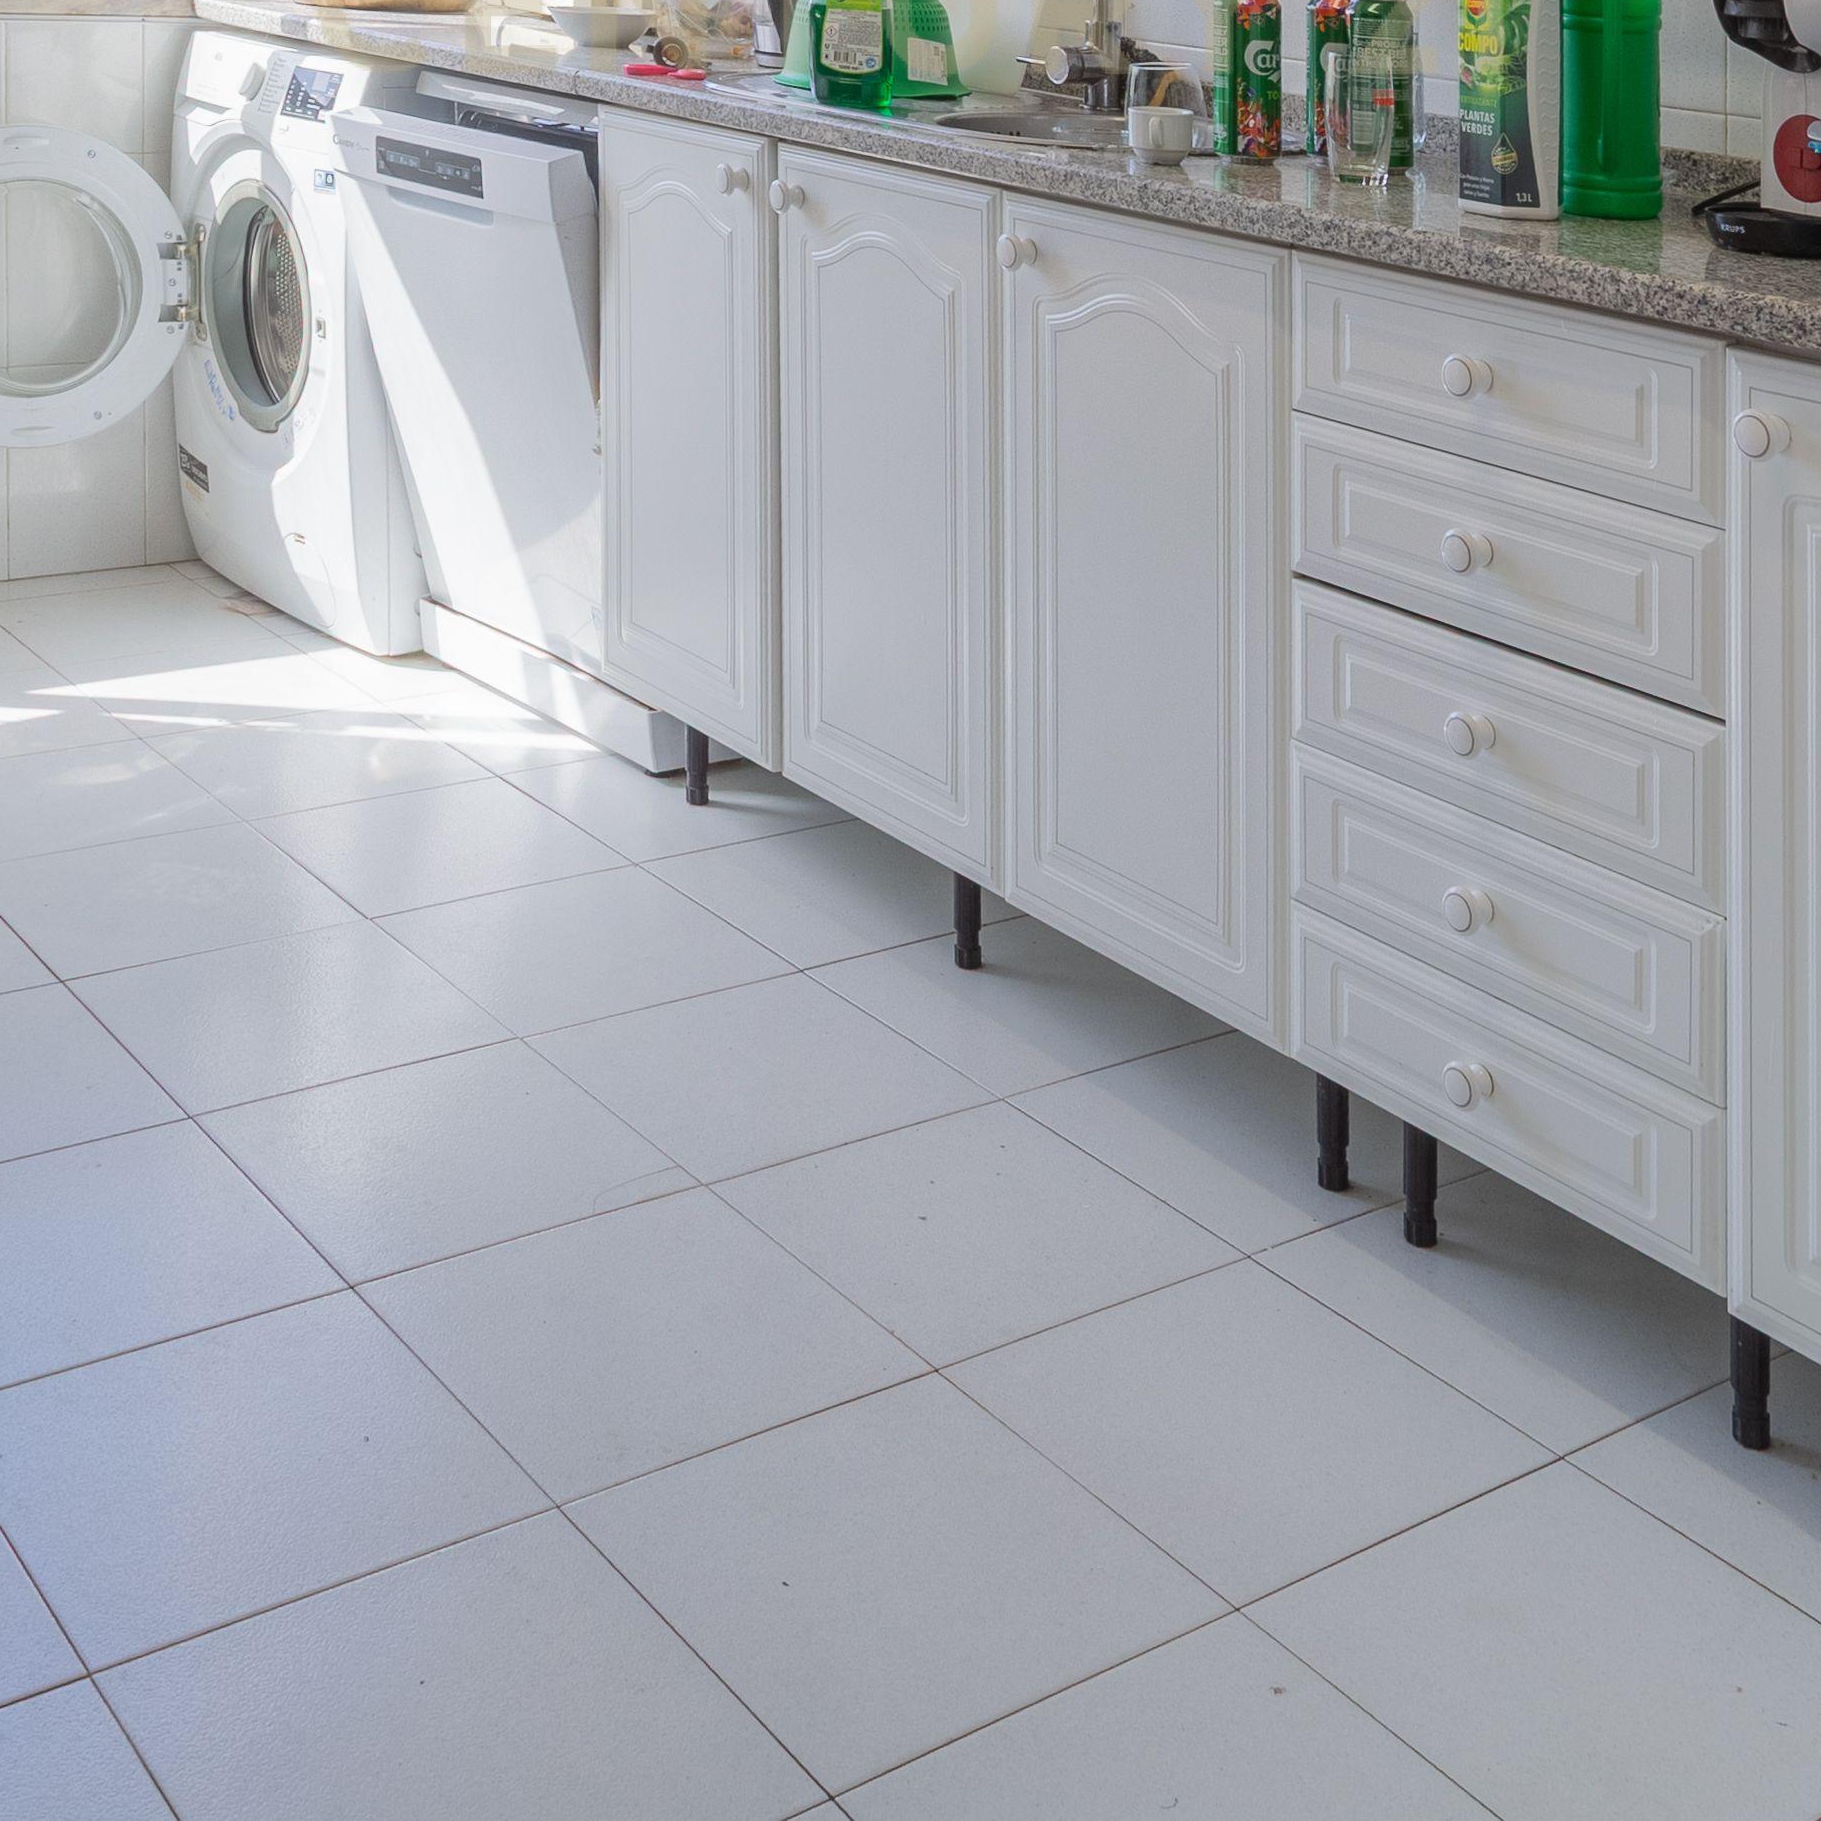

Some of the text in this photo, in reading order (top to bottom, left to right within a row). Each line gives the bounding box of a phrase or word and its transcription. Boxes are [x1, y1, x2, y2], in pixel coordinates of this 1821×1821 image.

[1458, 31, 1500, 57] COMPO
[1459, 108, 1496, 124] PLANTAS
[1461, 120, 1494, 137] VERDES
[1719, 221, 1747, 235] KRUPS
